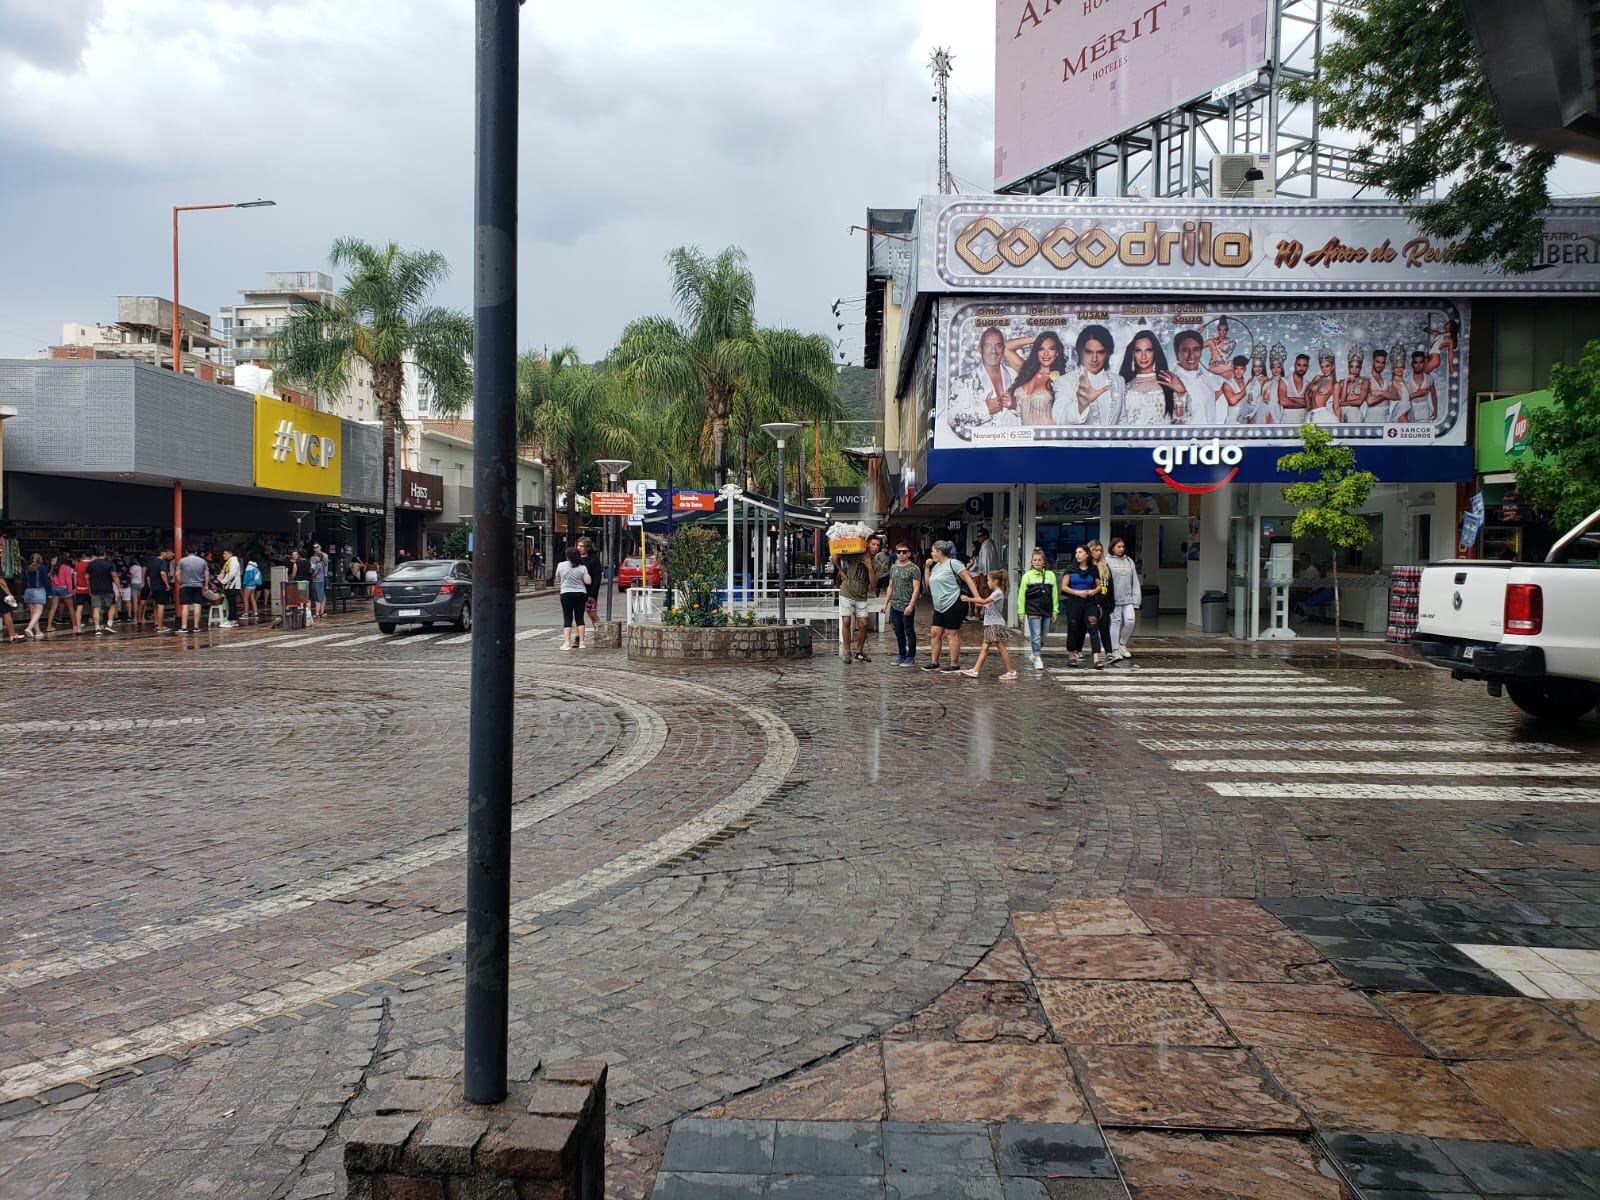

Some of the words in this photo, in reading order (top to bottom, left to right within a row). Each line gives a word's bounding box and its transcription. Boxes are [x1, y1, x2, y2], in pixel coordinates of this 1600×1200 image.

[1062, 0, 1167, 82] MÉRIT
[1092, 55, 1128, 81] HOTELES
[955, 216, 1253, 274] Cocodrilo
[1370, 238, 1398, 263] de
[1077, 311, 1109, 320] TUSAM
[272, 420, 336, 469] #VCP
[1152, 438, 1243, 473] grido
